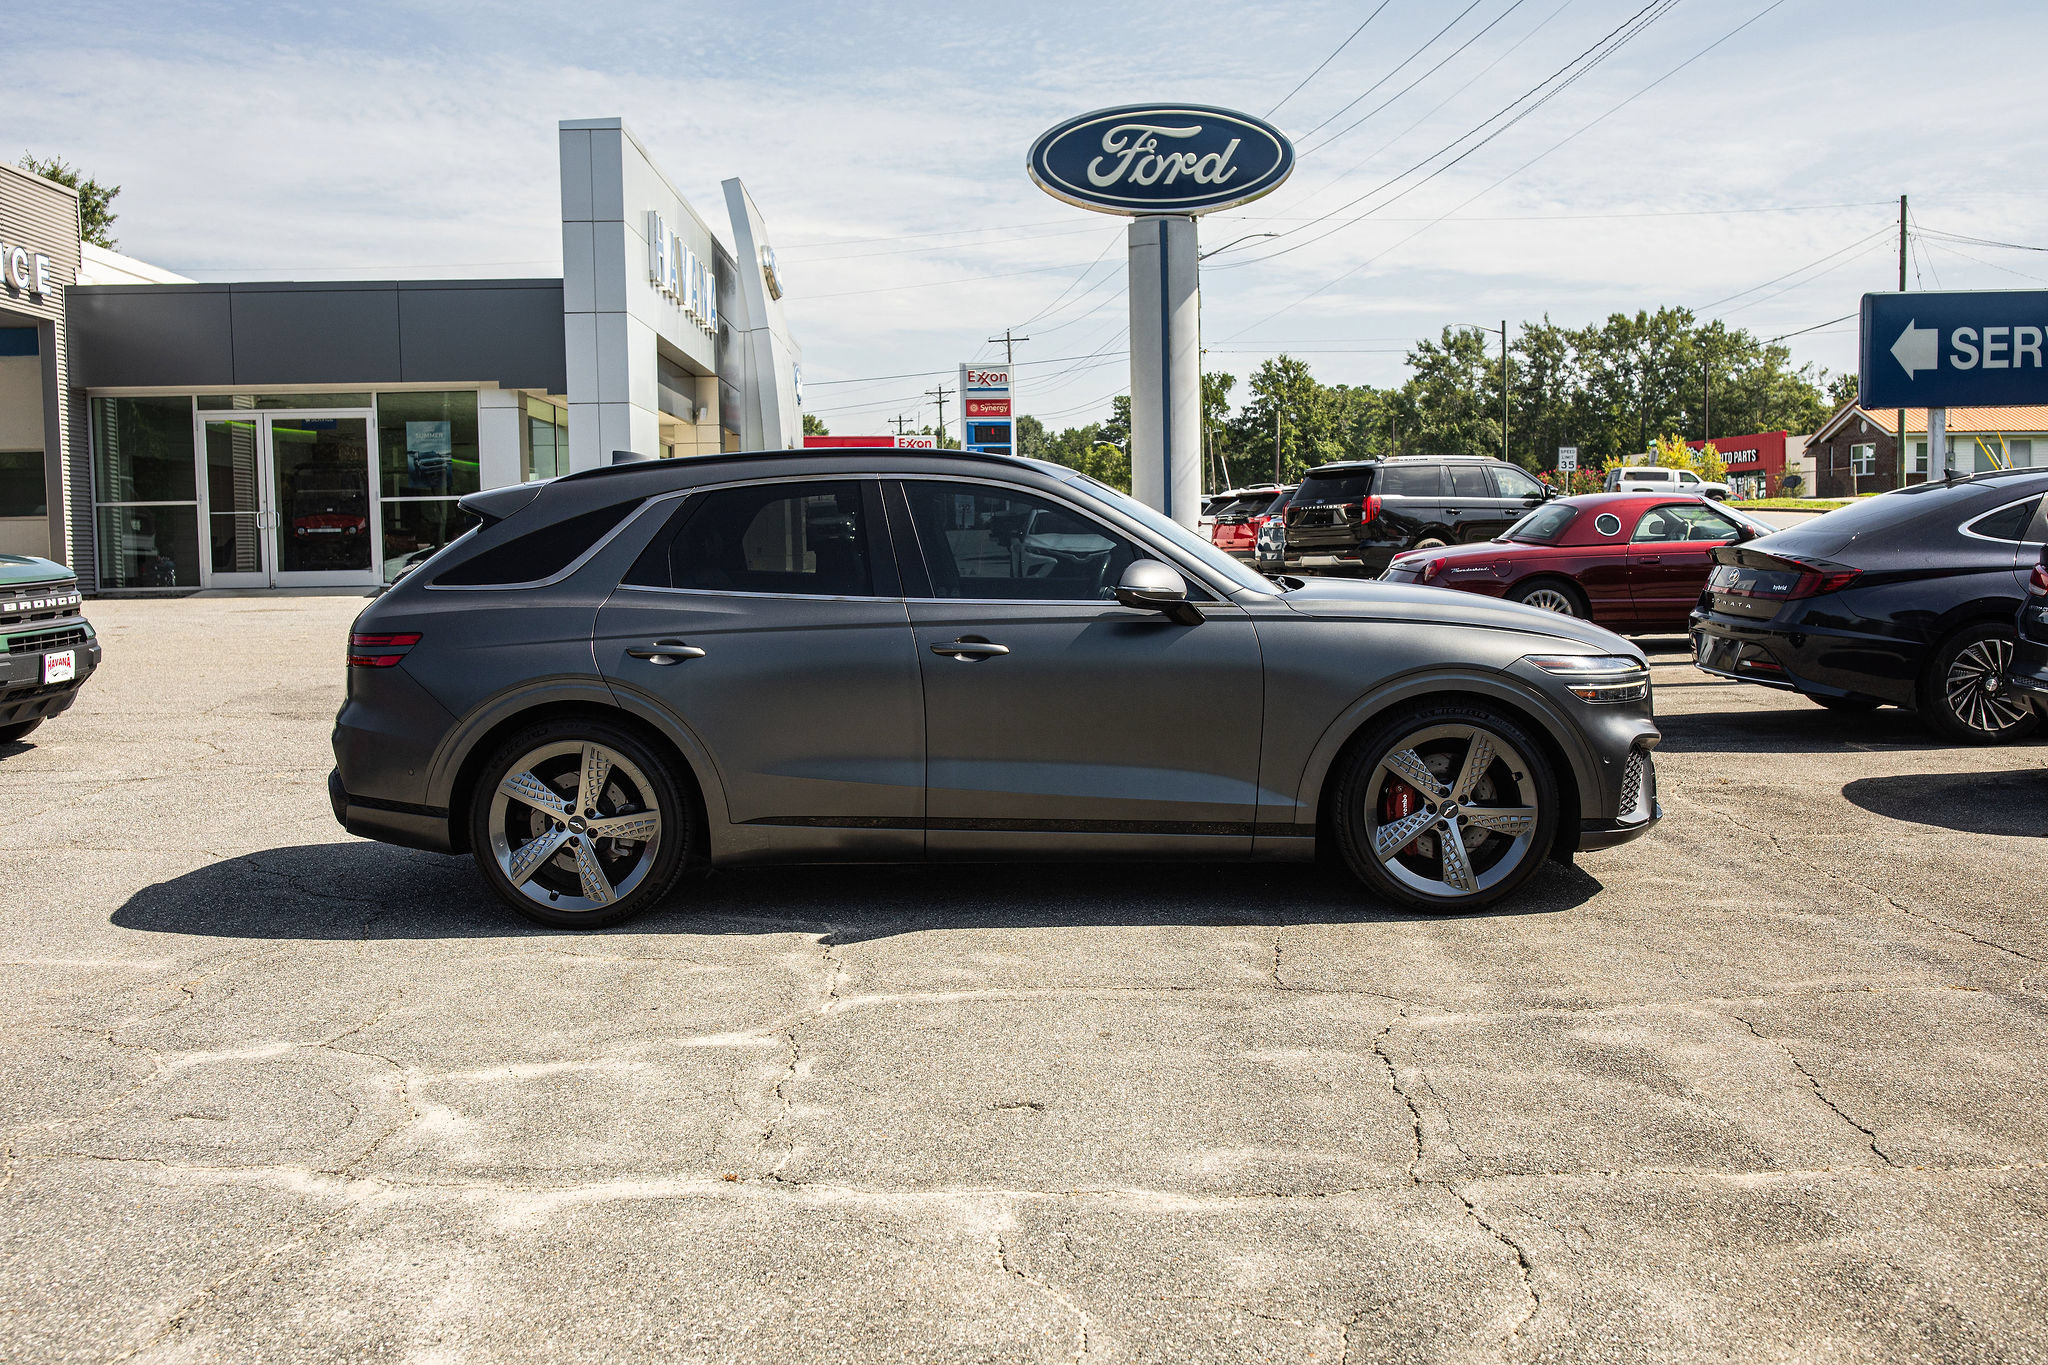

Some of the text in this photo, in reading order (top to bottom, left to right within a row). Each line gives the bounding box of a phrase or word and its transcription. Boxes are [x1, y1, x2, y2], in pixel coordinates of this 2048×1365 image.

[1087, 124, 1241, 187] Ford
[648, 211, 719, 334] HAVANA
[1950, 326, 2048, 371] SER
[967, 370, 1008, 387] Exxon
[980, 404, 1008, 413] Synergy
[898, 438, 932, 448] Exxon
[1733, 449, 1757, 464] PARTS
[1561, 461, 1575, 469] 35
[3, 595, 77, 612] BRONCO
[48, 656, 72, 672] HAVANA
